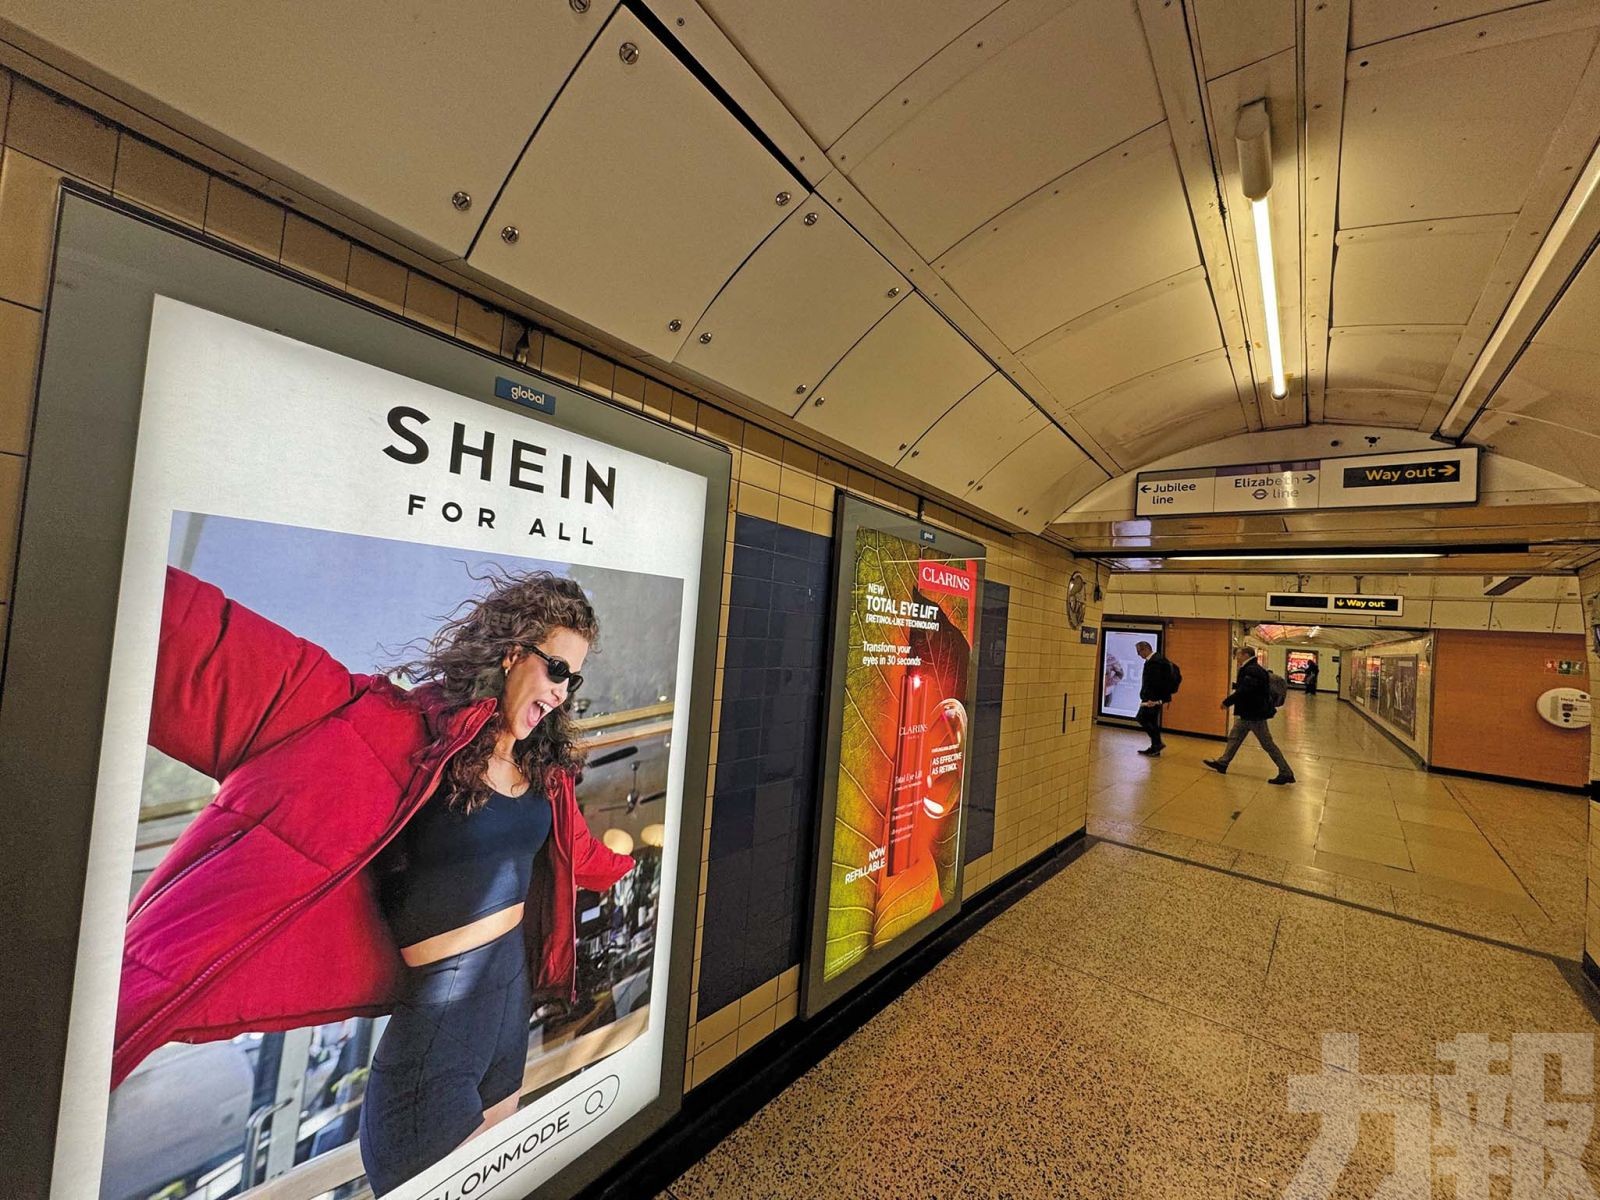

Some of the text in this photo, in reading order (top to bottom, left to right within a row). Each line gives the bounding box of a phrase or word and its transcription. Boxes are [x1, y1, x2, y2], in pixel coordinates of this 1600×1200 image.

[511, 385, 545, 406] global
[382, 405, 617, 510] SHEIN
[1365, 466, 1435, 483] Way out
[1152, 482, 1197, 493] Jubilee
[1272, 489, 1299, 498] line
[1152, 494, 1174, 505] line
[407, 493, 594, 546] FOR ALL
[922, 566, 970, 591] CLARINS
[867, 582, 885, 595] NEW
[866, 595, 939, 620] TOTAL EYE LIFT
[1346, 599, 1386, 610] Way out
[862, 640, 911, 656] Transform your
[862, 654, 922, 667] eyes in 30 seconds
[932, 756, 939, 765] AS
[931, 766, 939, 775] AS
[868, 845, 887, 861] NOW
[844, 857, 886, 885] REFILLABLE
